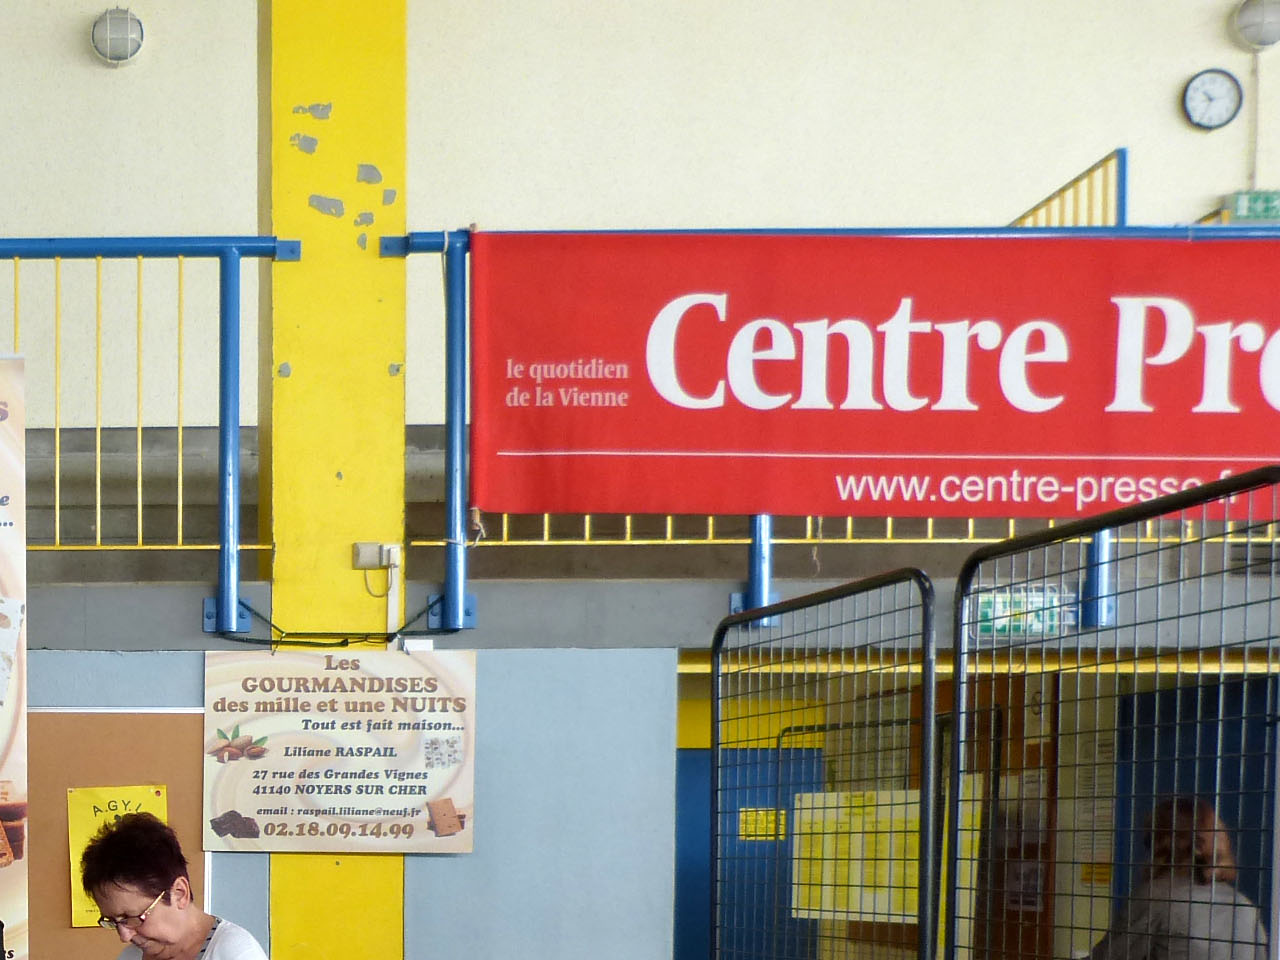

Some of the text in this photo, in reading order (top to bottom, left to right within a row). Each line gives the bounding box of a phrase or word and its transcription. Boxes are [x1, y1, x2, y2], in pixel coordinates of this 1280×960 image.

[645, 292, 1280, 413] Centre Pr
[506, 358, 629, 384] le quotidien
[506, 388, 629, 407] de la Vienne
[324, 655, 360, 671] Les
[241, 677, 438, 693] GOURMANDISES
[213, 697, 466, 713] des mille et une NUITS
[302, 719, 464, 734] Tout est fait maison...
[284, 747, 397, 757] Liliane RASPAIL
[252, 769, 428, 783] 27 rue des Grandes Vignes
[252, 785, 427, 795] 41140 NOYERS SUR CHER
[256, 807, 288, 816] email
[263, 823, 415, 839] 02.18.09.14.99
